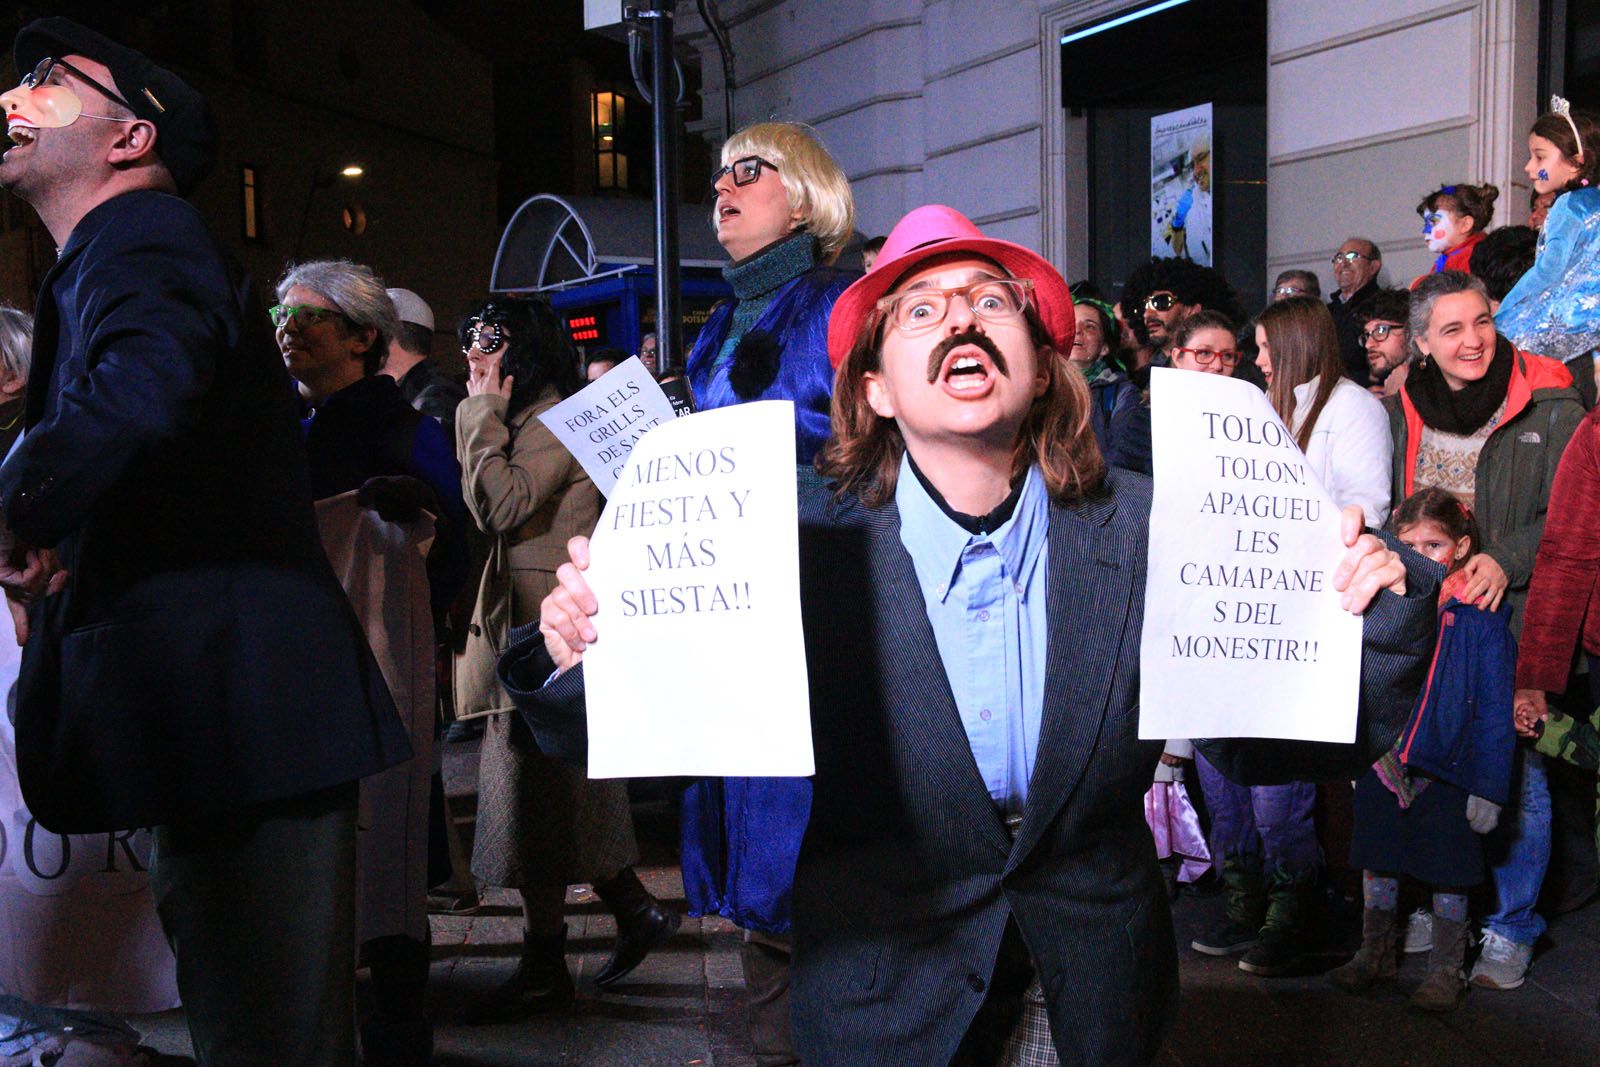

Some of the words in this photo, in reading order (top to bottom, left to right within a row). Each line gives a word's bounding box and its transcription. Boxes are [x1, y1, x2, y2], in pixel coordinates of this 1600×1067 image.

[564, 404, 609, 433] FORA
[607, 380, 640, 408] ELS
[675, 406, 690, 417] AR
[589, 404, 645, 443] GRILLS
[597, 445, 622, 464] DE
[631, 447, 736, 487] MENOS
[1215, 455, 1306, 485] TOLON!
[613, 495, 718, 530] FIESTA
[730, 490, 751, 518] Y
[1200, 492, 1321, 522] APAGUEU
[646, 532, 716, 571] MÁS
[1235, 530, 1280, 554] LES
[1180, 562, 1324, 592] CAMAPANE
[620, 582, 751, 617] SIESTA!!
[1213, 600, 1227, 623] S
[1235, 602, 1282, 625] DEL
[1171, 635, 1318, 662] MONESTIR!!
